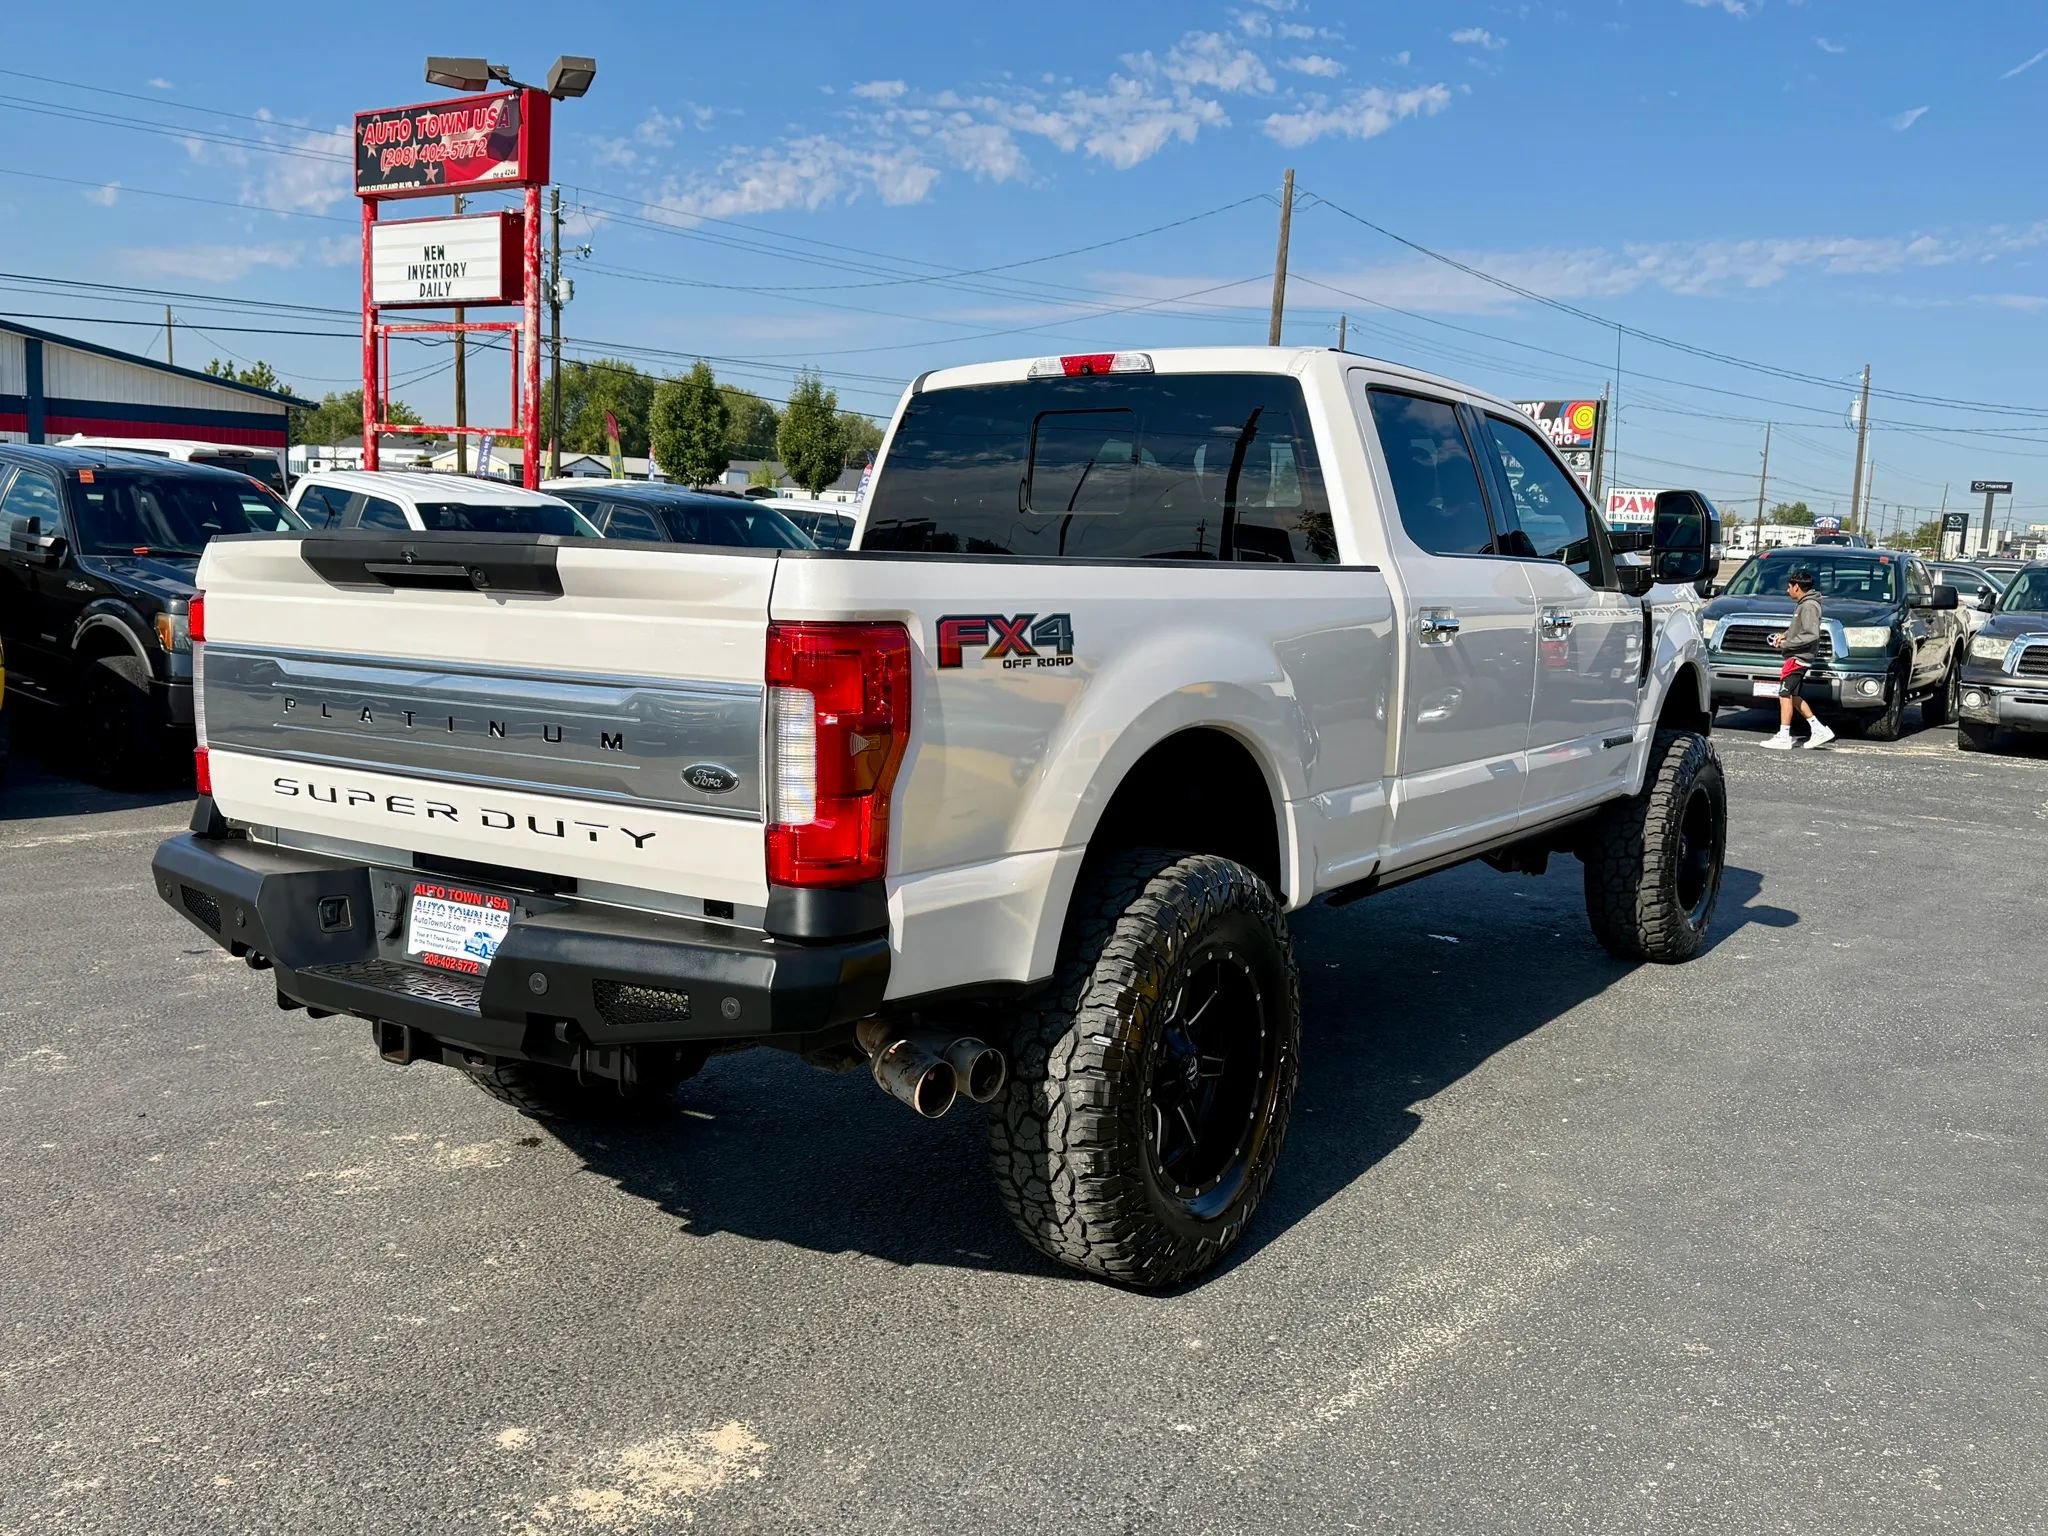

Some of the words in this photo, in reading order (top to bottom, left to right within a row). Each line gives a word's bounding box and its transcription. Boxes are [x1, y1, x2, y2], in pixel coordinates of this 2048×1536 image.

[362, 117, 411, 146] AUTO
[416, 110, 468, 139] TOWN
[472, 104, 511, 133] USA
[380, 146, 416, 172] (208)
[419, 137, 488, 162] 402-5772
[424, 244, 445, 262] NEW
[408, 262, 467, 280] INVENTORY
[419, 281, 452, 297] DAILY
[935, 613, 1074, 670] FX4
[1002, 658, 1031, 669] OFF
[1037, 656, 1074, 667] ROAD
[284, 697, 625, 752] PLATINUM
[692, 768, 723, 788] Ford
[273, 776, 459, 823] SUPER
[481, 809, 658, 849] DUTY
[413, 883, 445, 899] AUTO
[448, 888, 482, 905] TOWN
[485, 895, 509, 910] USA
[413, 915, 467, 932] AutoTownUS.com
